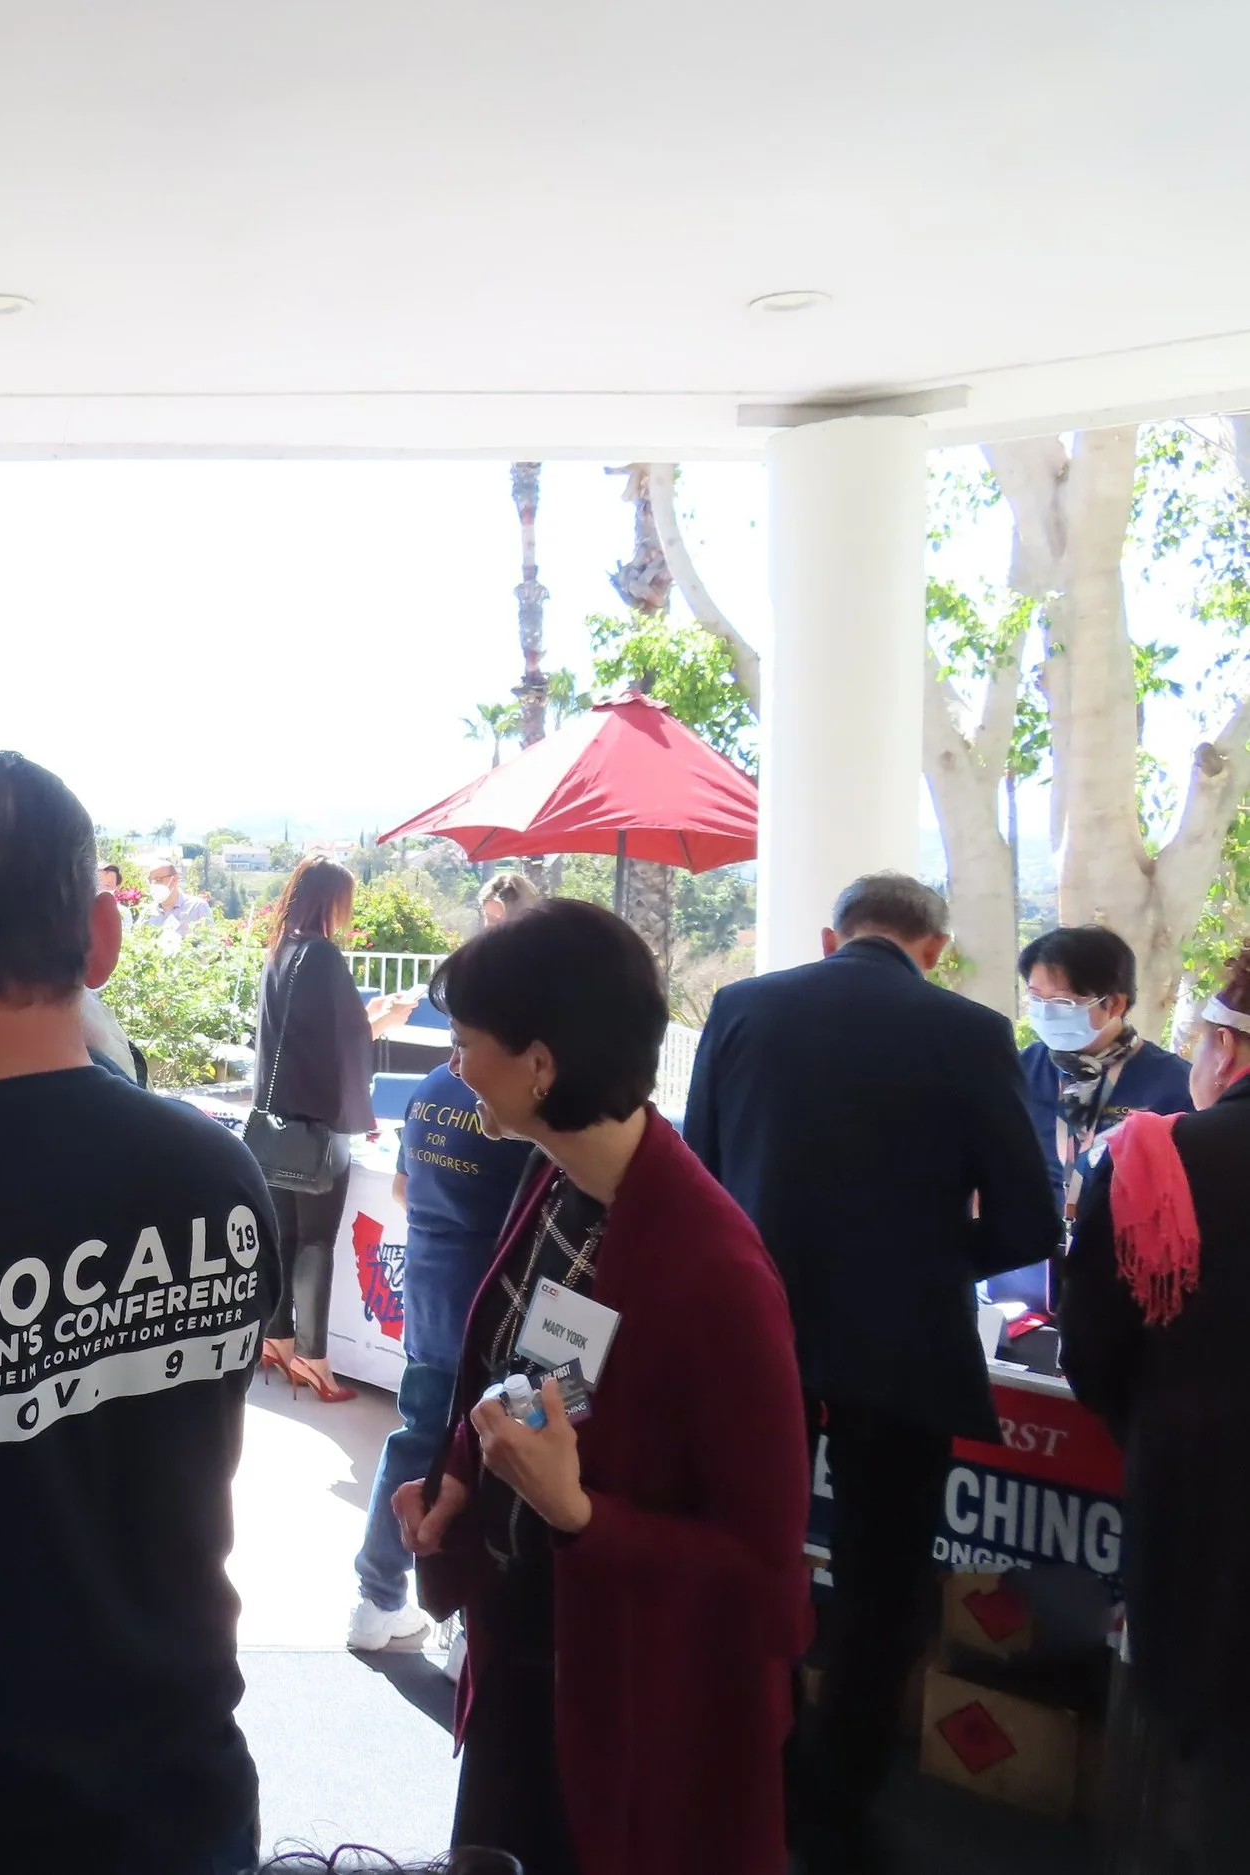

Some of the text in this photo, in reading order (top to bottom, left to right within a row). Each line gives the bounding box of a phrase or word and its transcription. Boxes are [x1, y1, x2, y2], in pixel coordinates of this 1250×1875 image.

[426, 1132, 447, 1147] FOR
[437, 1106, 484, 1135] CHIN
[417, 1149, 479, 1175] CONGRESS
[53, 1270, 258, 1344] CONFERENCE
[44, 1323, 166, 1369] CONVENTION
[174, 1307, 243, 1333] CENTER
[542, 1318, 589, 1350] MARY YORK
[164, 1336, 251, 1380] 9TH
[998, 1417, 1069, 1457] RST
[945, 1466, 1123, 1574] CHING
